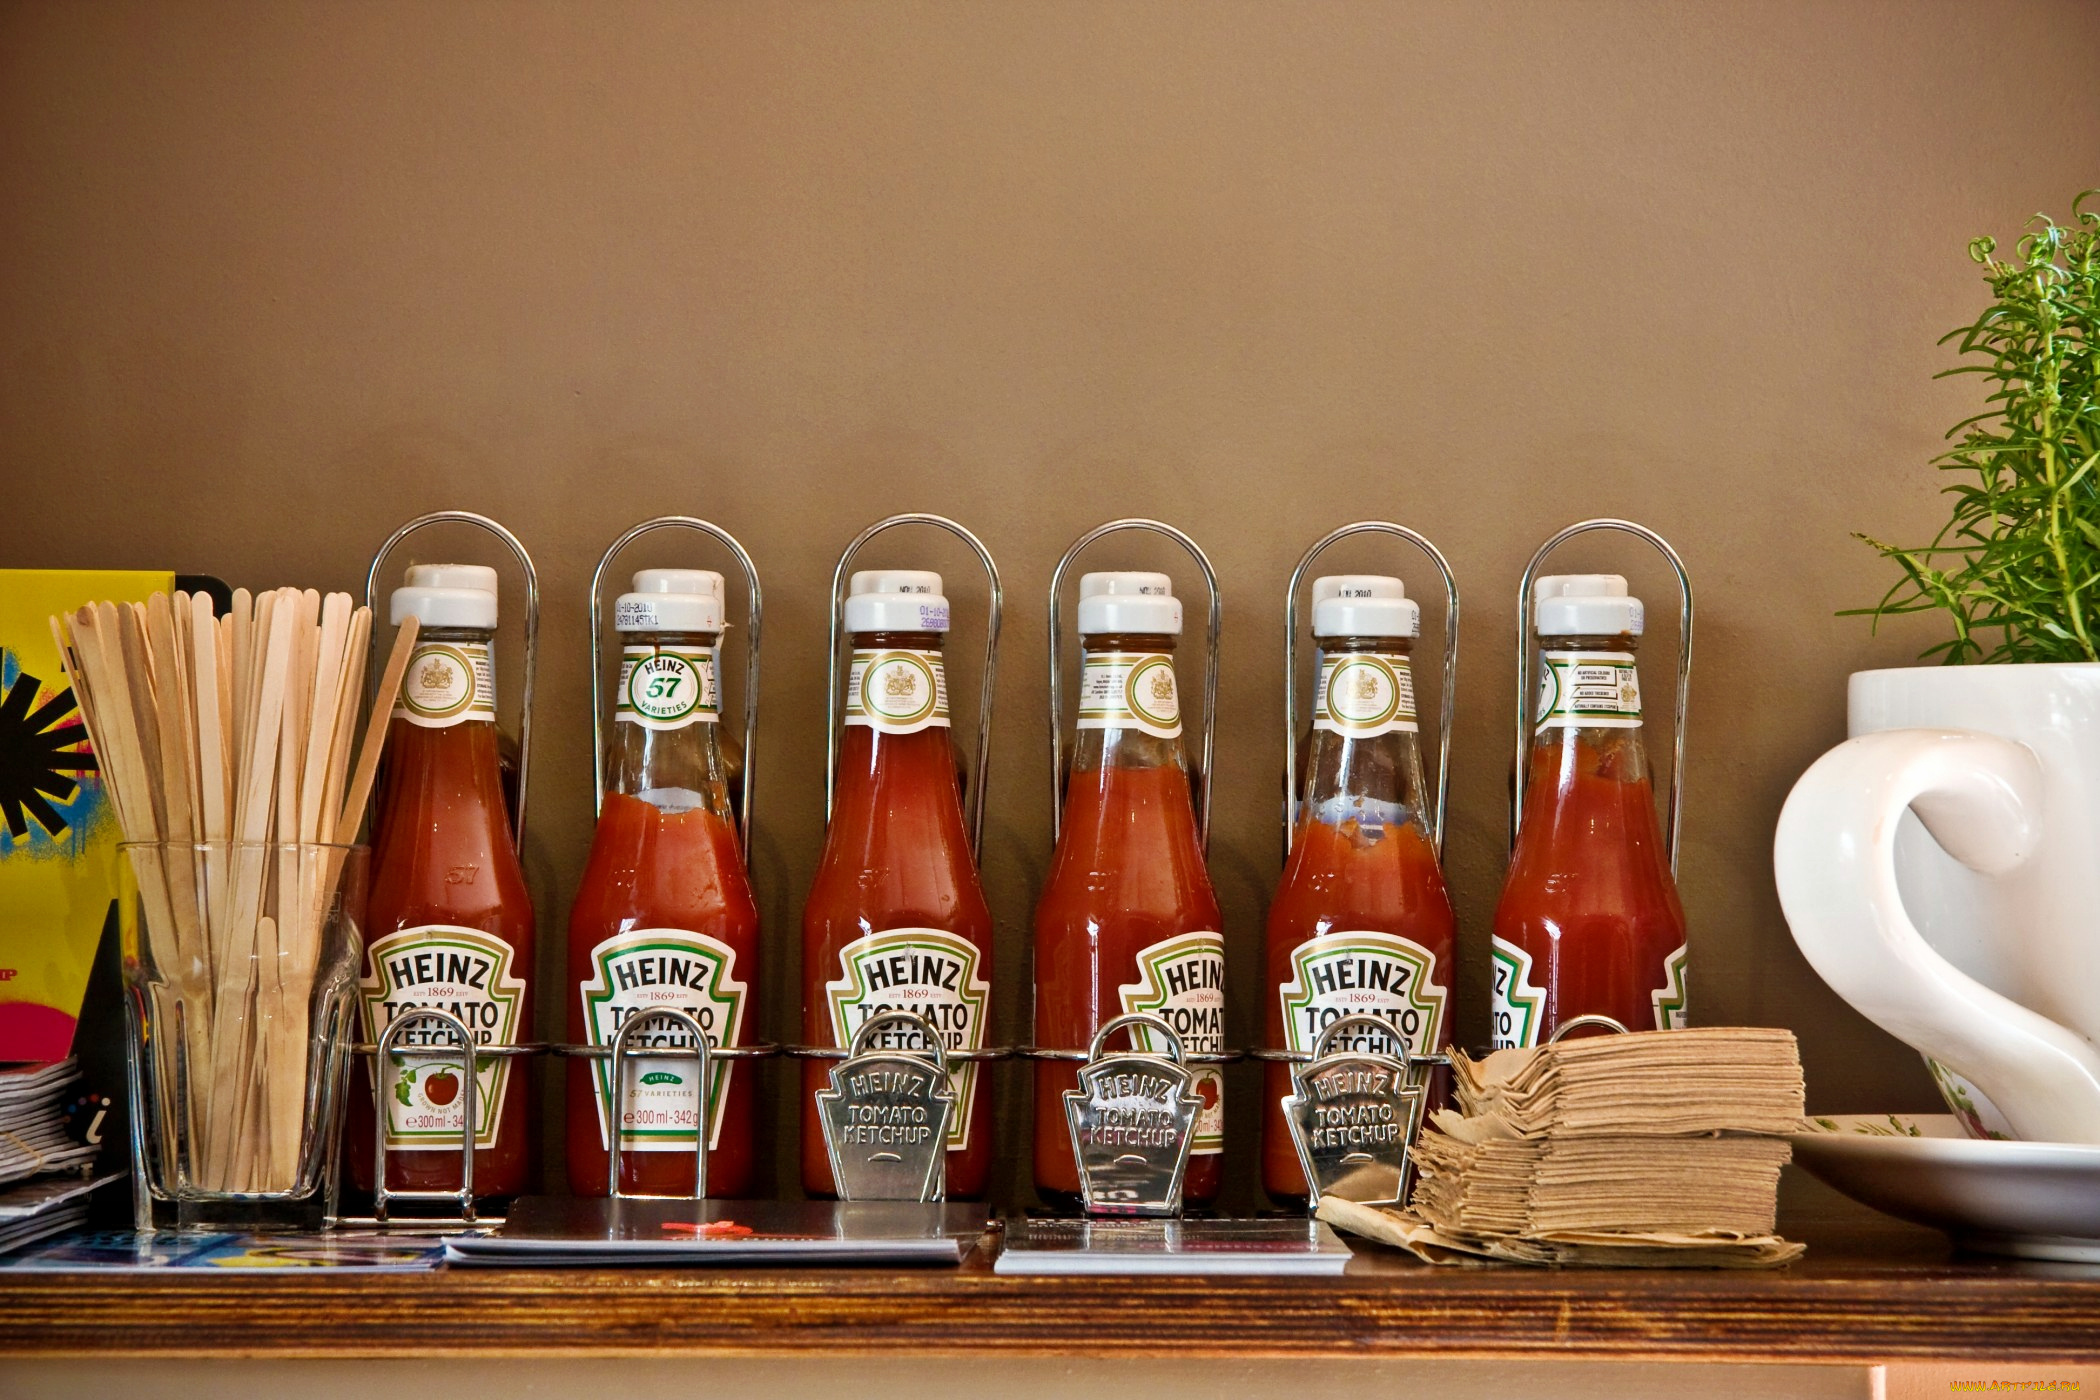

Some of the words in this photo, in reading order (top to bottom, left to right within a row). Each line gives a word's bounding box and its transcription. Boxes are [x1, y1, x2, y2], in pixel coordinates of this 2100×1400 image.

[645, 659, 685, 675] HEINZ
[646, 678, 682, 698] 57
[641, 700, 687, 715] VARIETIES
[389, 952, 490, 990] HEINZ
[615, 957, 709, 992] HEINZ
[864, 955, 961, 992] HEINZ
[1165, 959, 1225, 997] HEIN
[1312, 958, 1411, 997] HEINZ
[427, 987, 455, 997] 1869
[650, 991, 675, 1001] 1869
[903, 989, 929, 998] 1869
[1196, 994, 1214, 1003] 1869
[1350, 993, 1376, 1003] 1869
[629, 1090, 642, 1098] 57
[850, 1072, 925, 1098] HEINZ
[1098, 1073, 1174, 1104] HEINZ
[1314, 1071, 1388, 1100] HEINZ
[848, 1105, 928, 1125] TOMATO
[1095, 1106, 1175, 1128] TOMATO
[1315, 1103, 1393, 1126] TOMATO
[843, 1125, 932, 1146] KETCHUP
[1090, 1125, 1179, 1149] KETCHUP
[1311, 1123, 1400, 1149] KETCHUP
